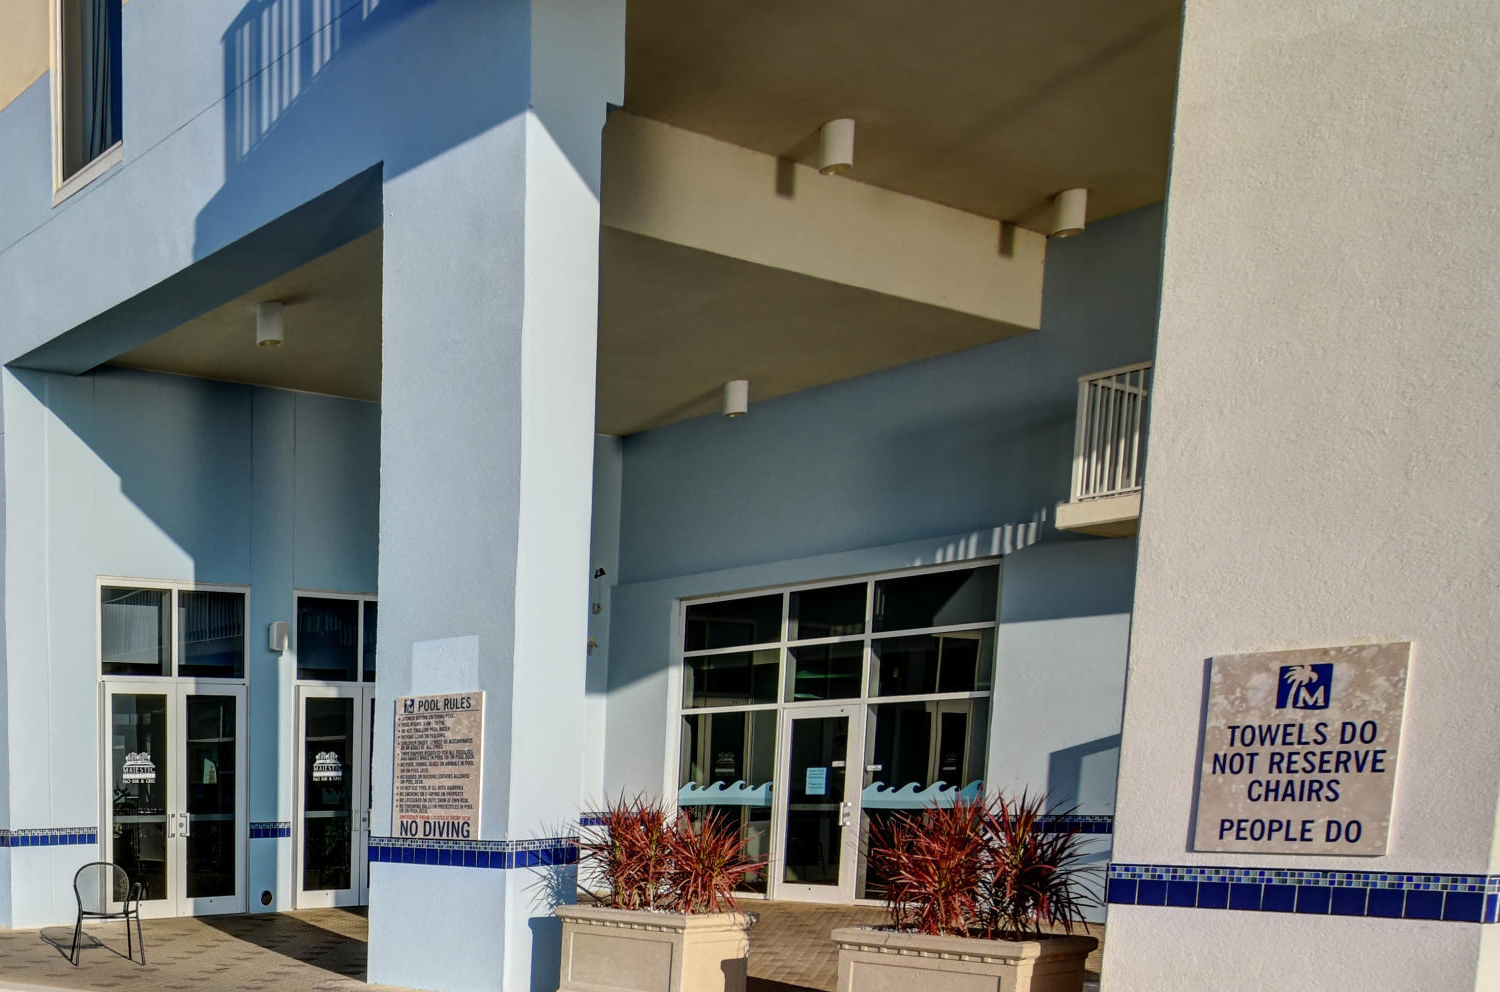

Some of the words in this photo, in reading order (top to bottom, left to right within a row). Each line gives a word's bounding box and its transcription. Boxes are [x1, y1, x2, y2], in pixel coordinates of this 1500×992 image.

[418, 699, 441, 712] POOL
[443, 696, 472, 710] RULES
[1227, 721, 1329, 748] TOWELS
[1340, 720, 1378, 745] DO
[1211, 752, 1259, 775] NOT
[1268, 749, 1387, 774] RESERVE
[1247, 778, 1341, 803] CHAIRS
[400, 820, 418, 837] NO
[423, 820, 471, 838] DIVING
[1218, 818, 1315, 842] PEOPLE
[1325, 819, 1362, 843] DO
